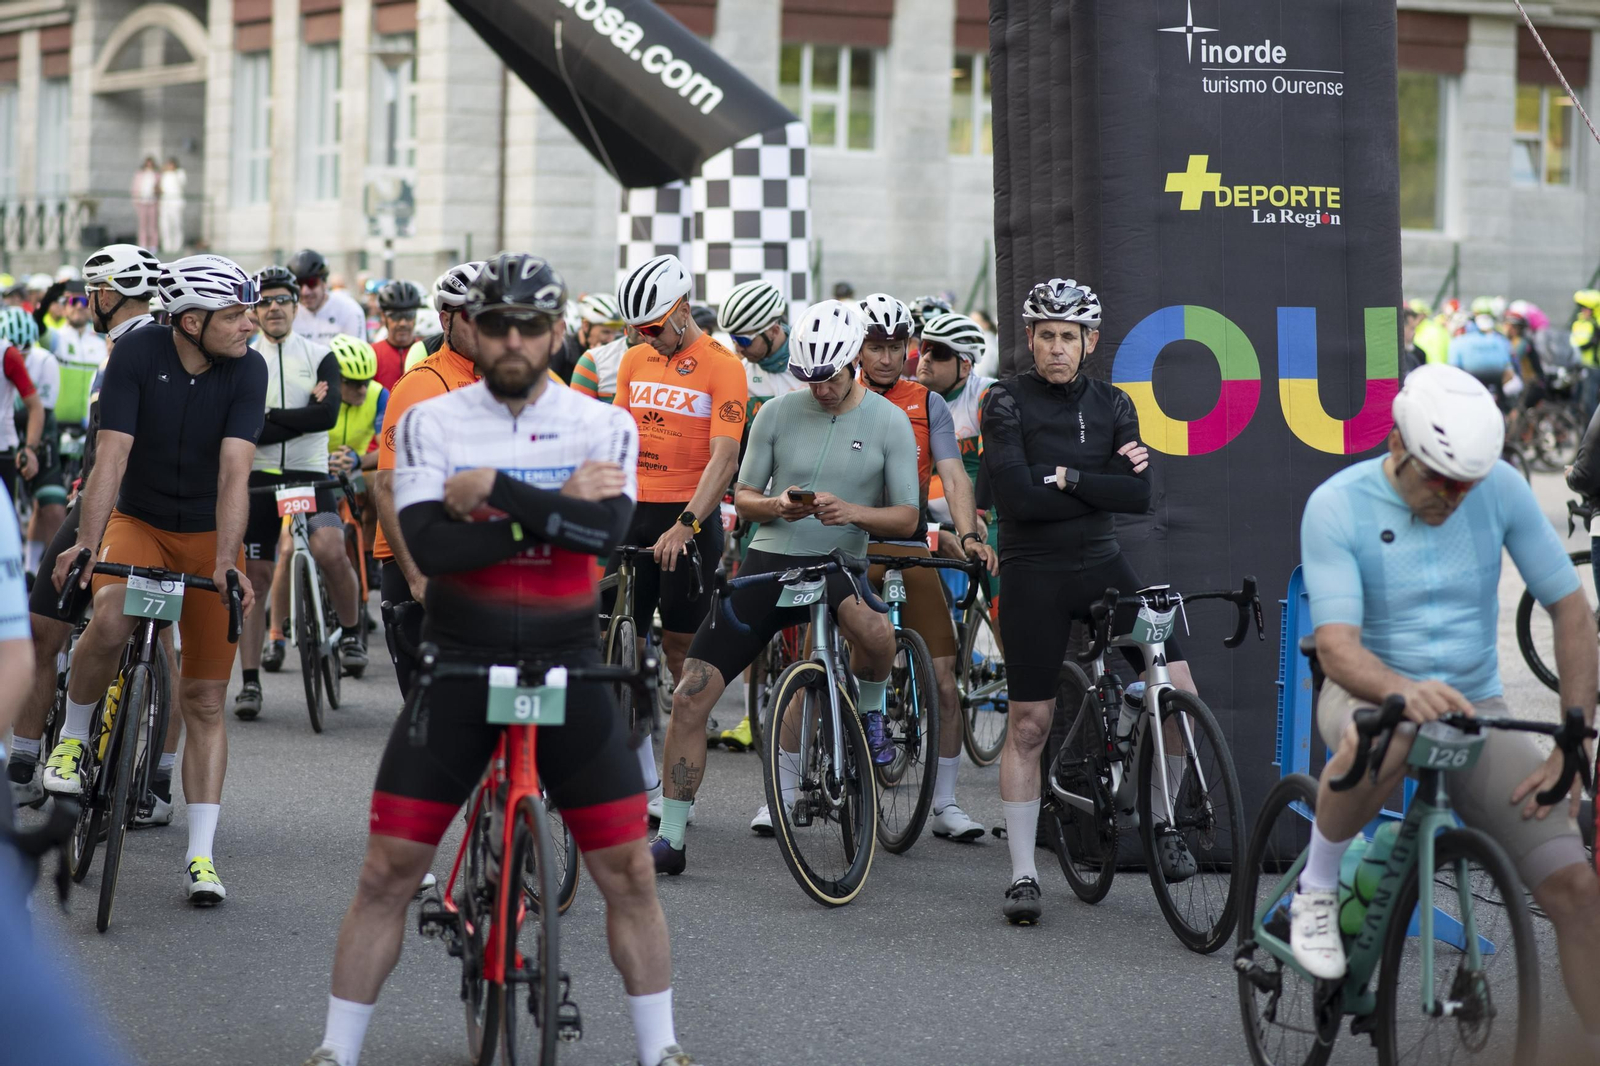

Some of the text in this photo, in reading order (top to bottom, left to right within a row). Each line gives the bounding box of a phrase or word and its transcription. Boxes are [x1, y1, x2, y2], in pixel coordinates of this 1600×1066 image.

[1200, 39, 1287, 64] inorde
[1202, 75, 1344, 96] turismo Ourense
[1214, 185, 1341, 209] DEPORTE
[1251, 209, 1276, 224] La
[1111, 304, 1400, 456] OU
[283, 498, 311, 514] 290
[792, 593, 815, 605] 90
[888, 585, 907, 600] 89
[142, 596, 166, 616] 77
[1145, 623, 1172, 642] 167
[514, 694, 541, 720] 91
[1427, 747, 1470, 767] 126
[1356, 815, 1421, 951] CANYON
